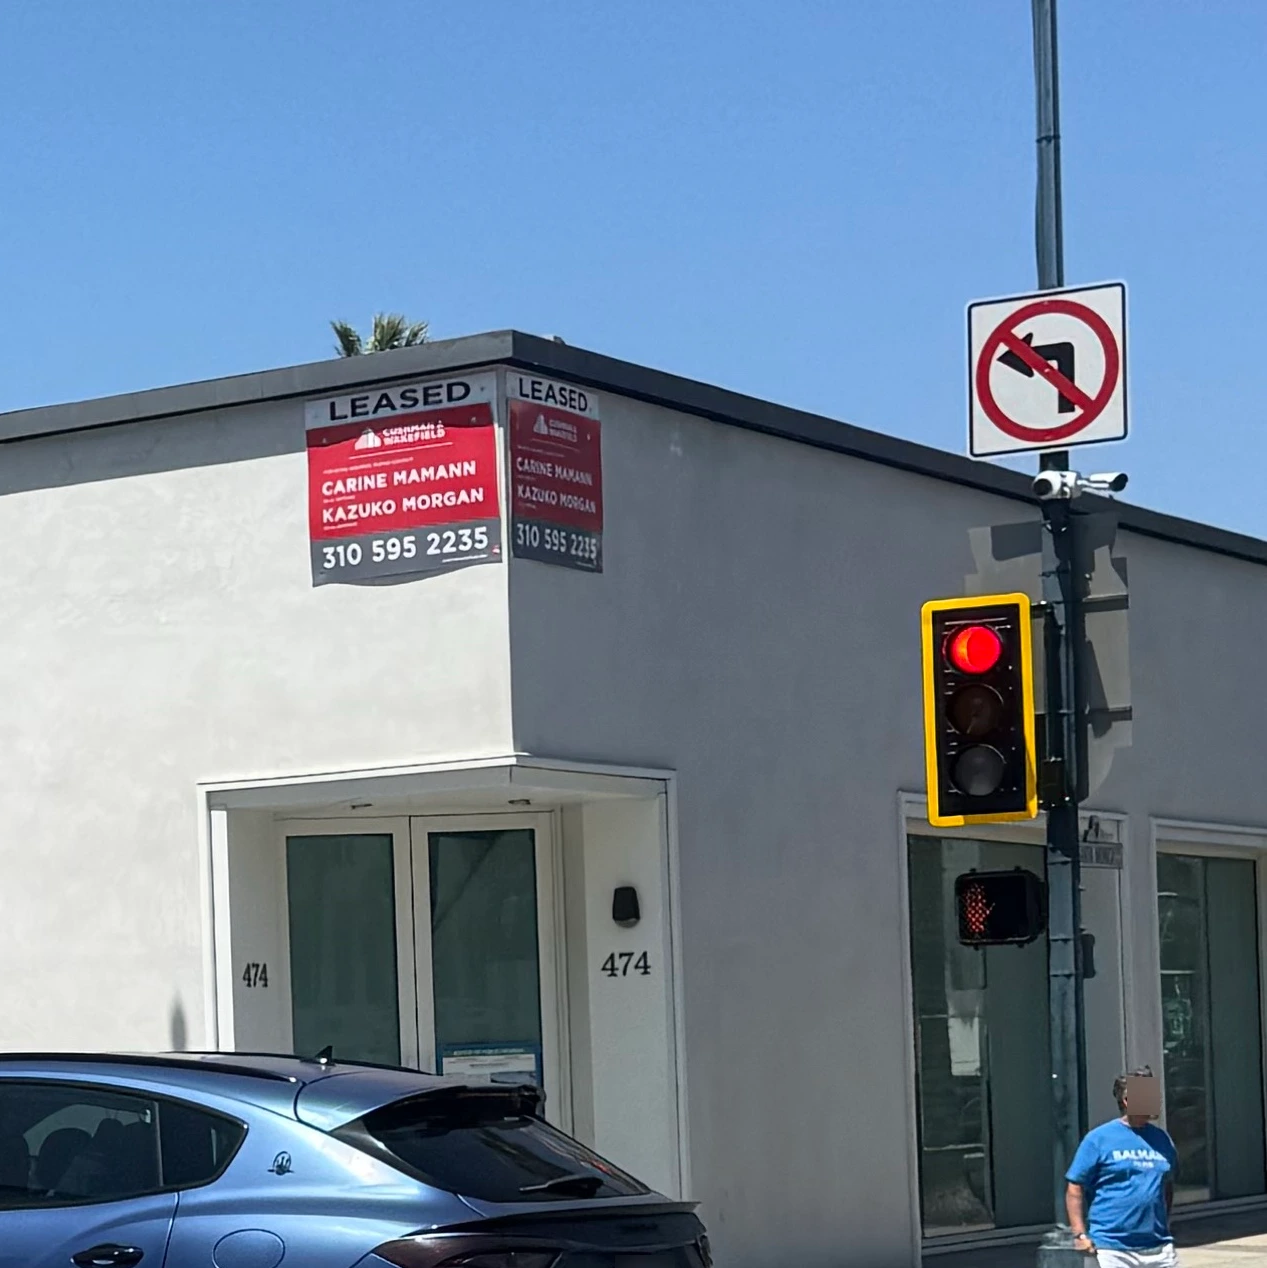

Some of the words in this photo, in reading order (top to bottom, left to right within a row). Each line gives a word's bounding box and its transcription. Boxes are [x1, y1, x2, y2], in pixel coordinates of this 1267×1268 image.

[329, 381, 471, 421] LEASED
[519, 377, 588, 412] LEASED
[322, 473, 388, 496] CARINE
[393, 460, 476, 486] MAMANN
[516, 457, 553, 477] CARINE
[554, 464, 593, 486] MAMANN
[322, 499, 396, 523] KAZUKO
[402, 487, 484, 512] MORGAN
[517, 484, 558, 506] KAZUKO
[559, 493, 596, 514] MORGAN
[322, 543, 363, 569] 310
[372, 536, 417, 563] 595
[426, 526, 489, 556] 2235
[516, 523, 540, 548] 310
[544, 528, 567, 553] 595
[570, 533, 597, 559] 2235
[243, 962, 268, 988] 474
[601, 951, 652, 978] 474
